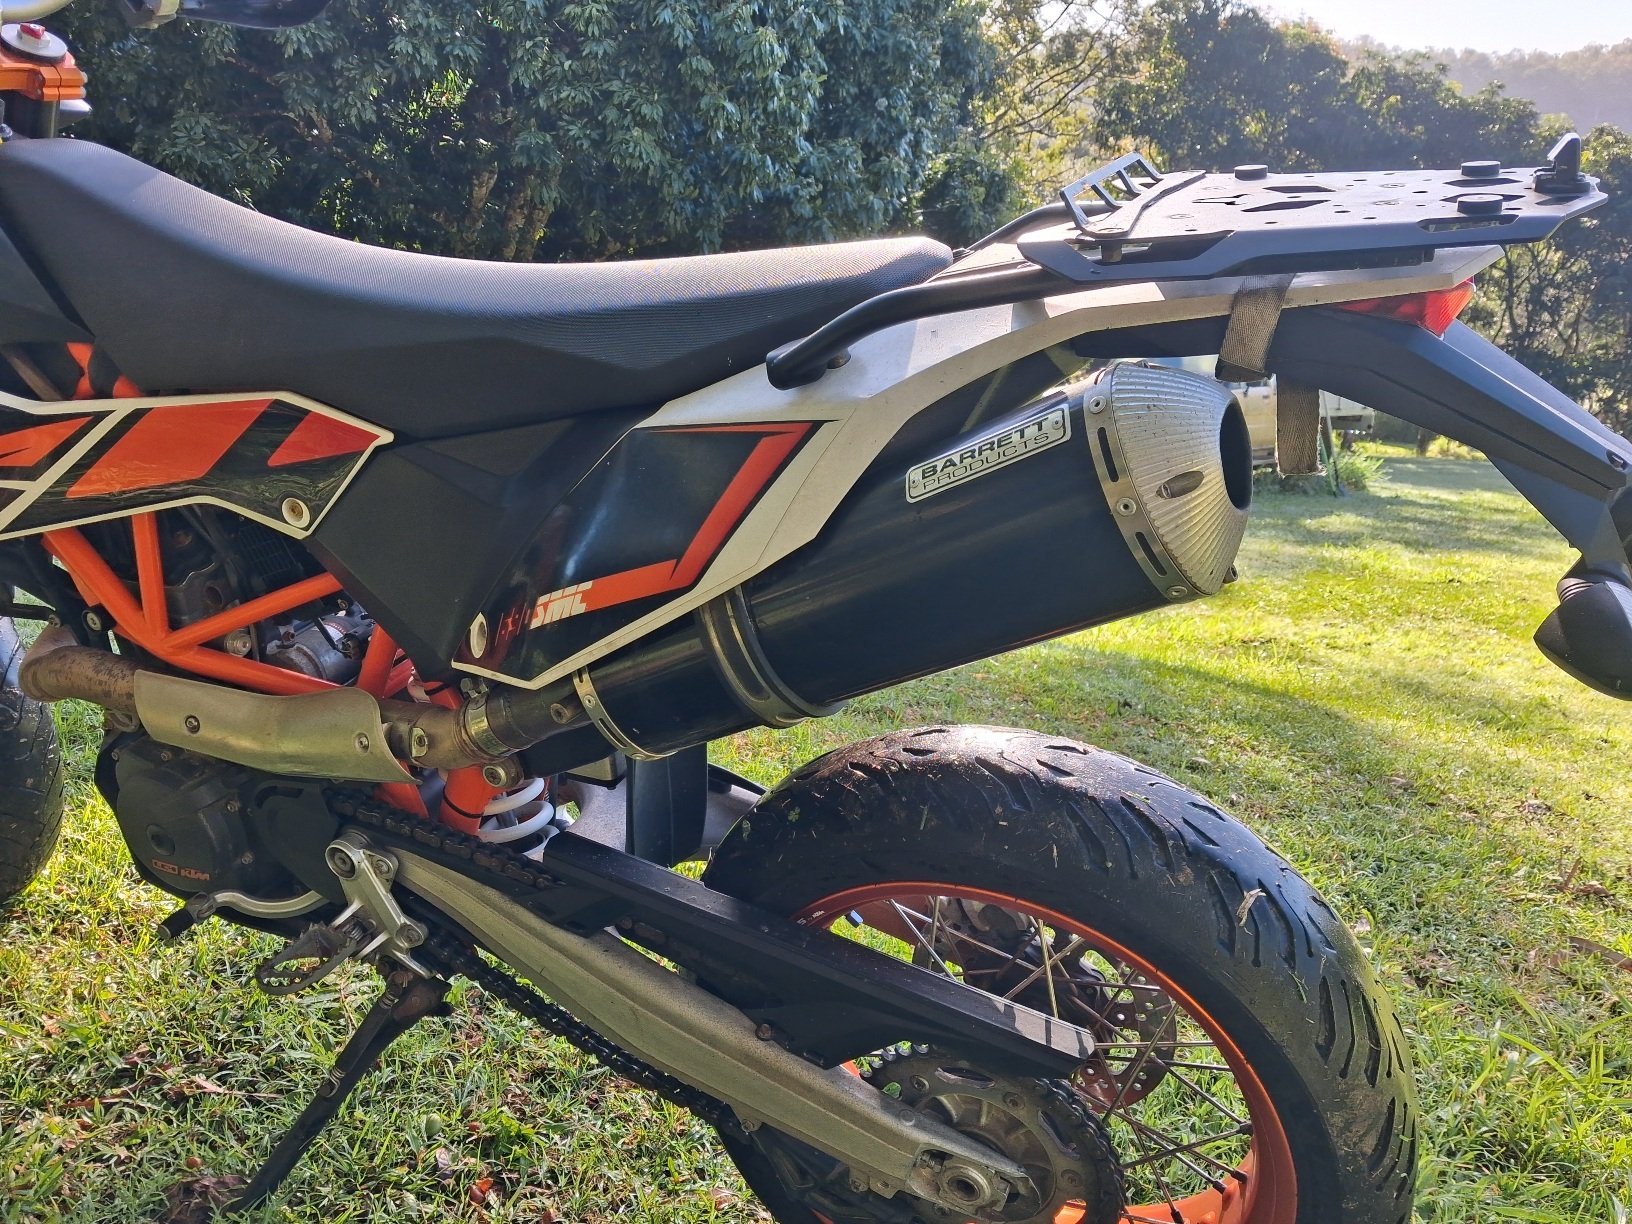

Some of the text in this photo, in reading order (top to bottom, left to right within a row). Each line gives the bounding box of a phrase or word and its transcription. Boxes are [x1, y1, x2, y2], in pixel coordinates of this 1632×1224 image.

[921, 417, 1049, 481] BARRETT
[923, 432, 1050, 491] PRODUCTS
[181, 868, 210, 881] KTM
